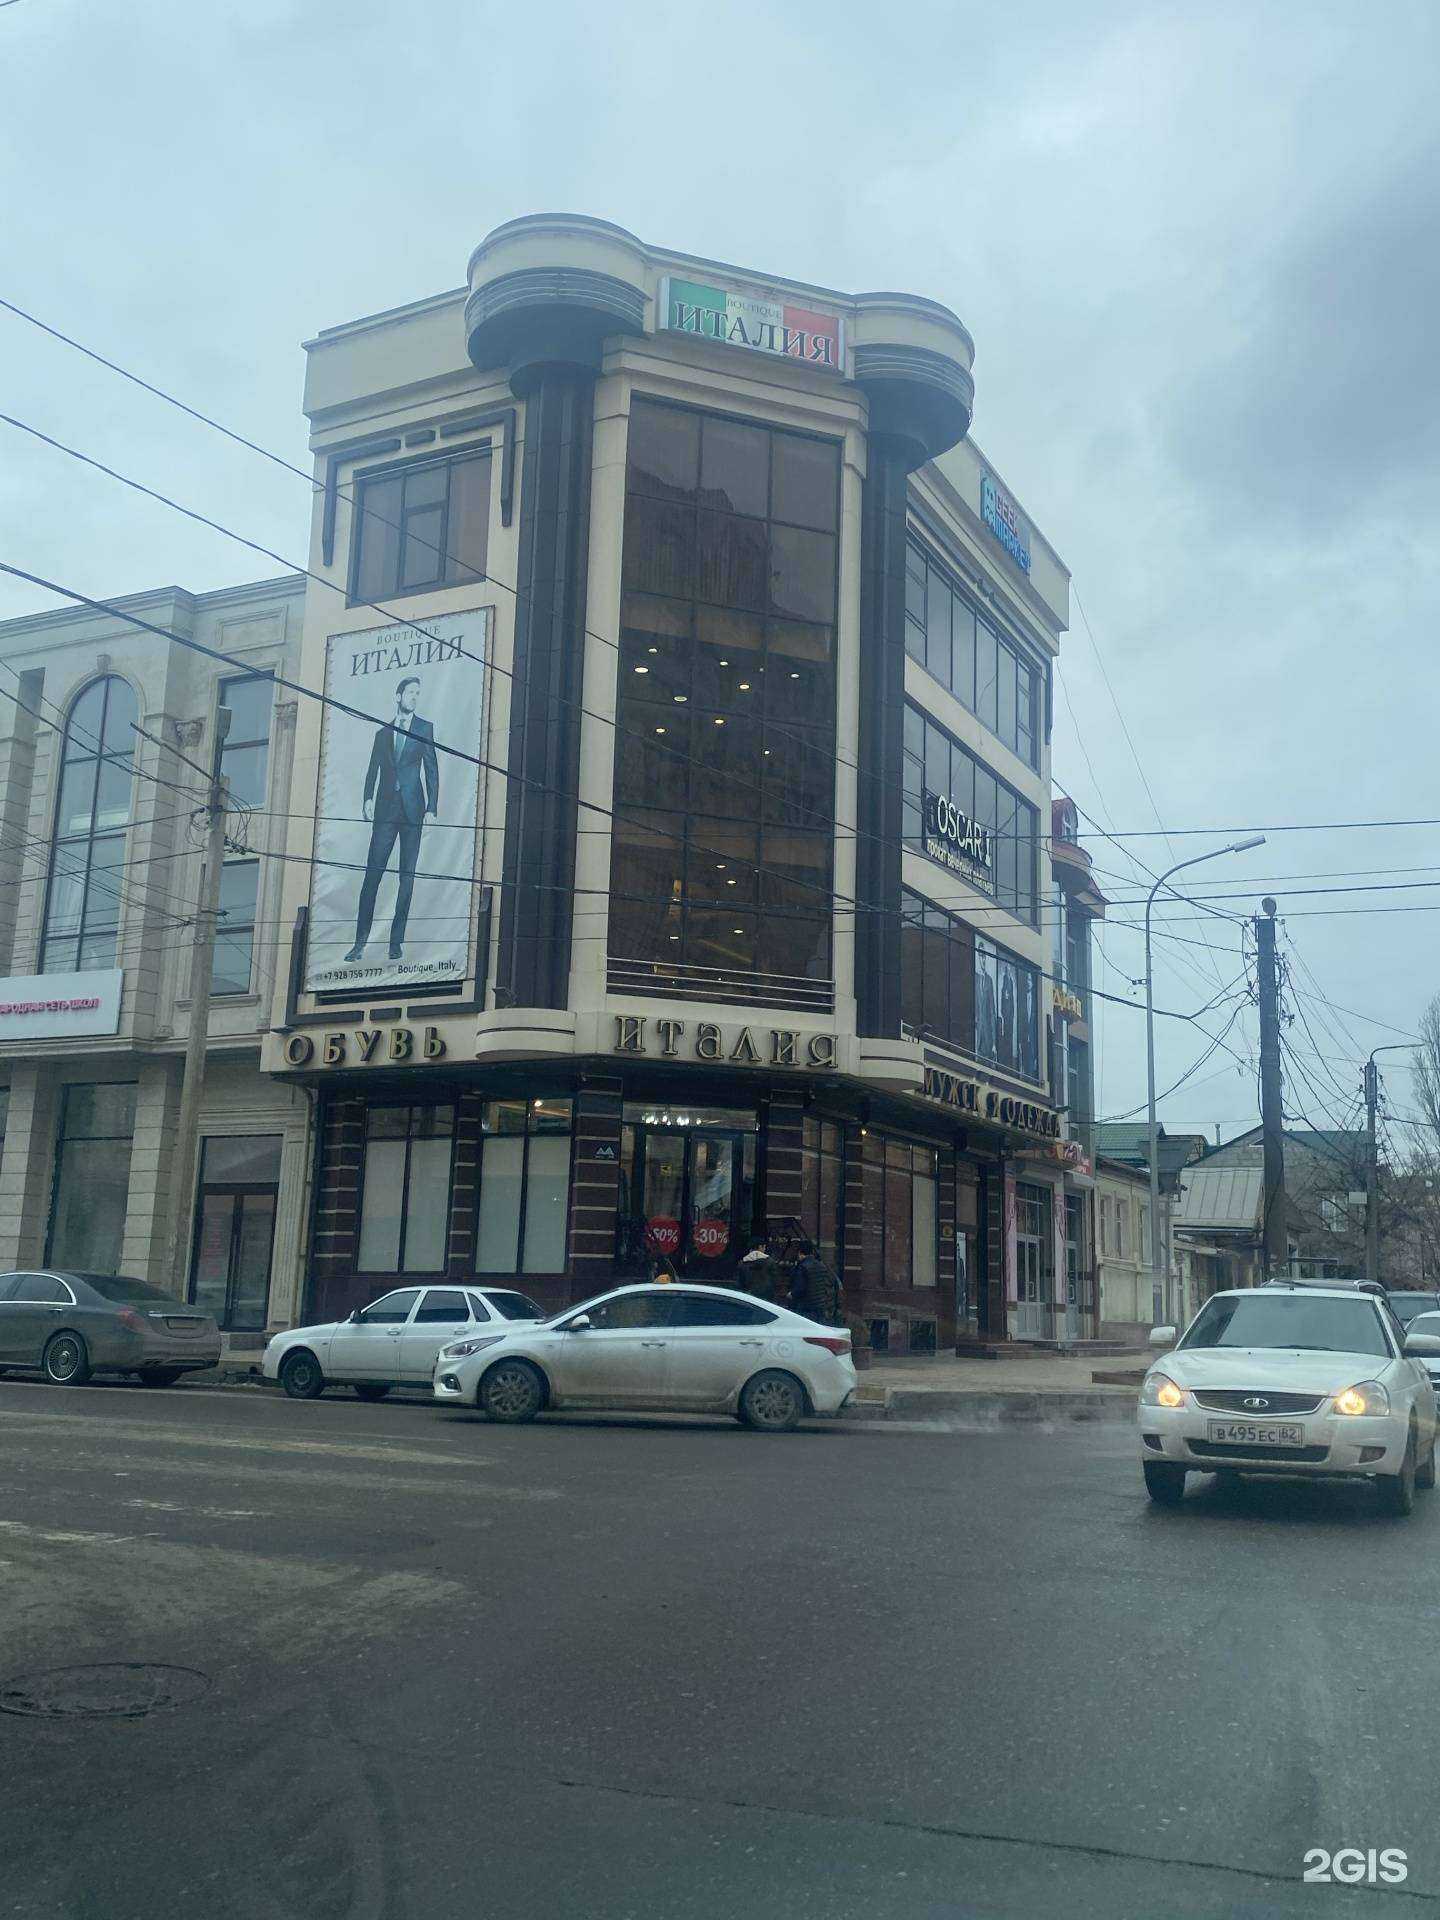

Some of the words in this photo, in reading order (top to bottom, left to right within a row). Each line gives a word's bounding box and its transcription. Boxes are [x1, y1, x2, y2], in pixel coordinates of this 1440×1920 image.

[675, 302, 833, 364] ИТАЛИЯ
[350, 635, 465, 676] ИТАЛИЯ
[377, 626, 441, 645] BOUTIQUE
[938, 795, 983, 861] OSCAR
[285, 1027, 447, 1066] ОБУВЬ
